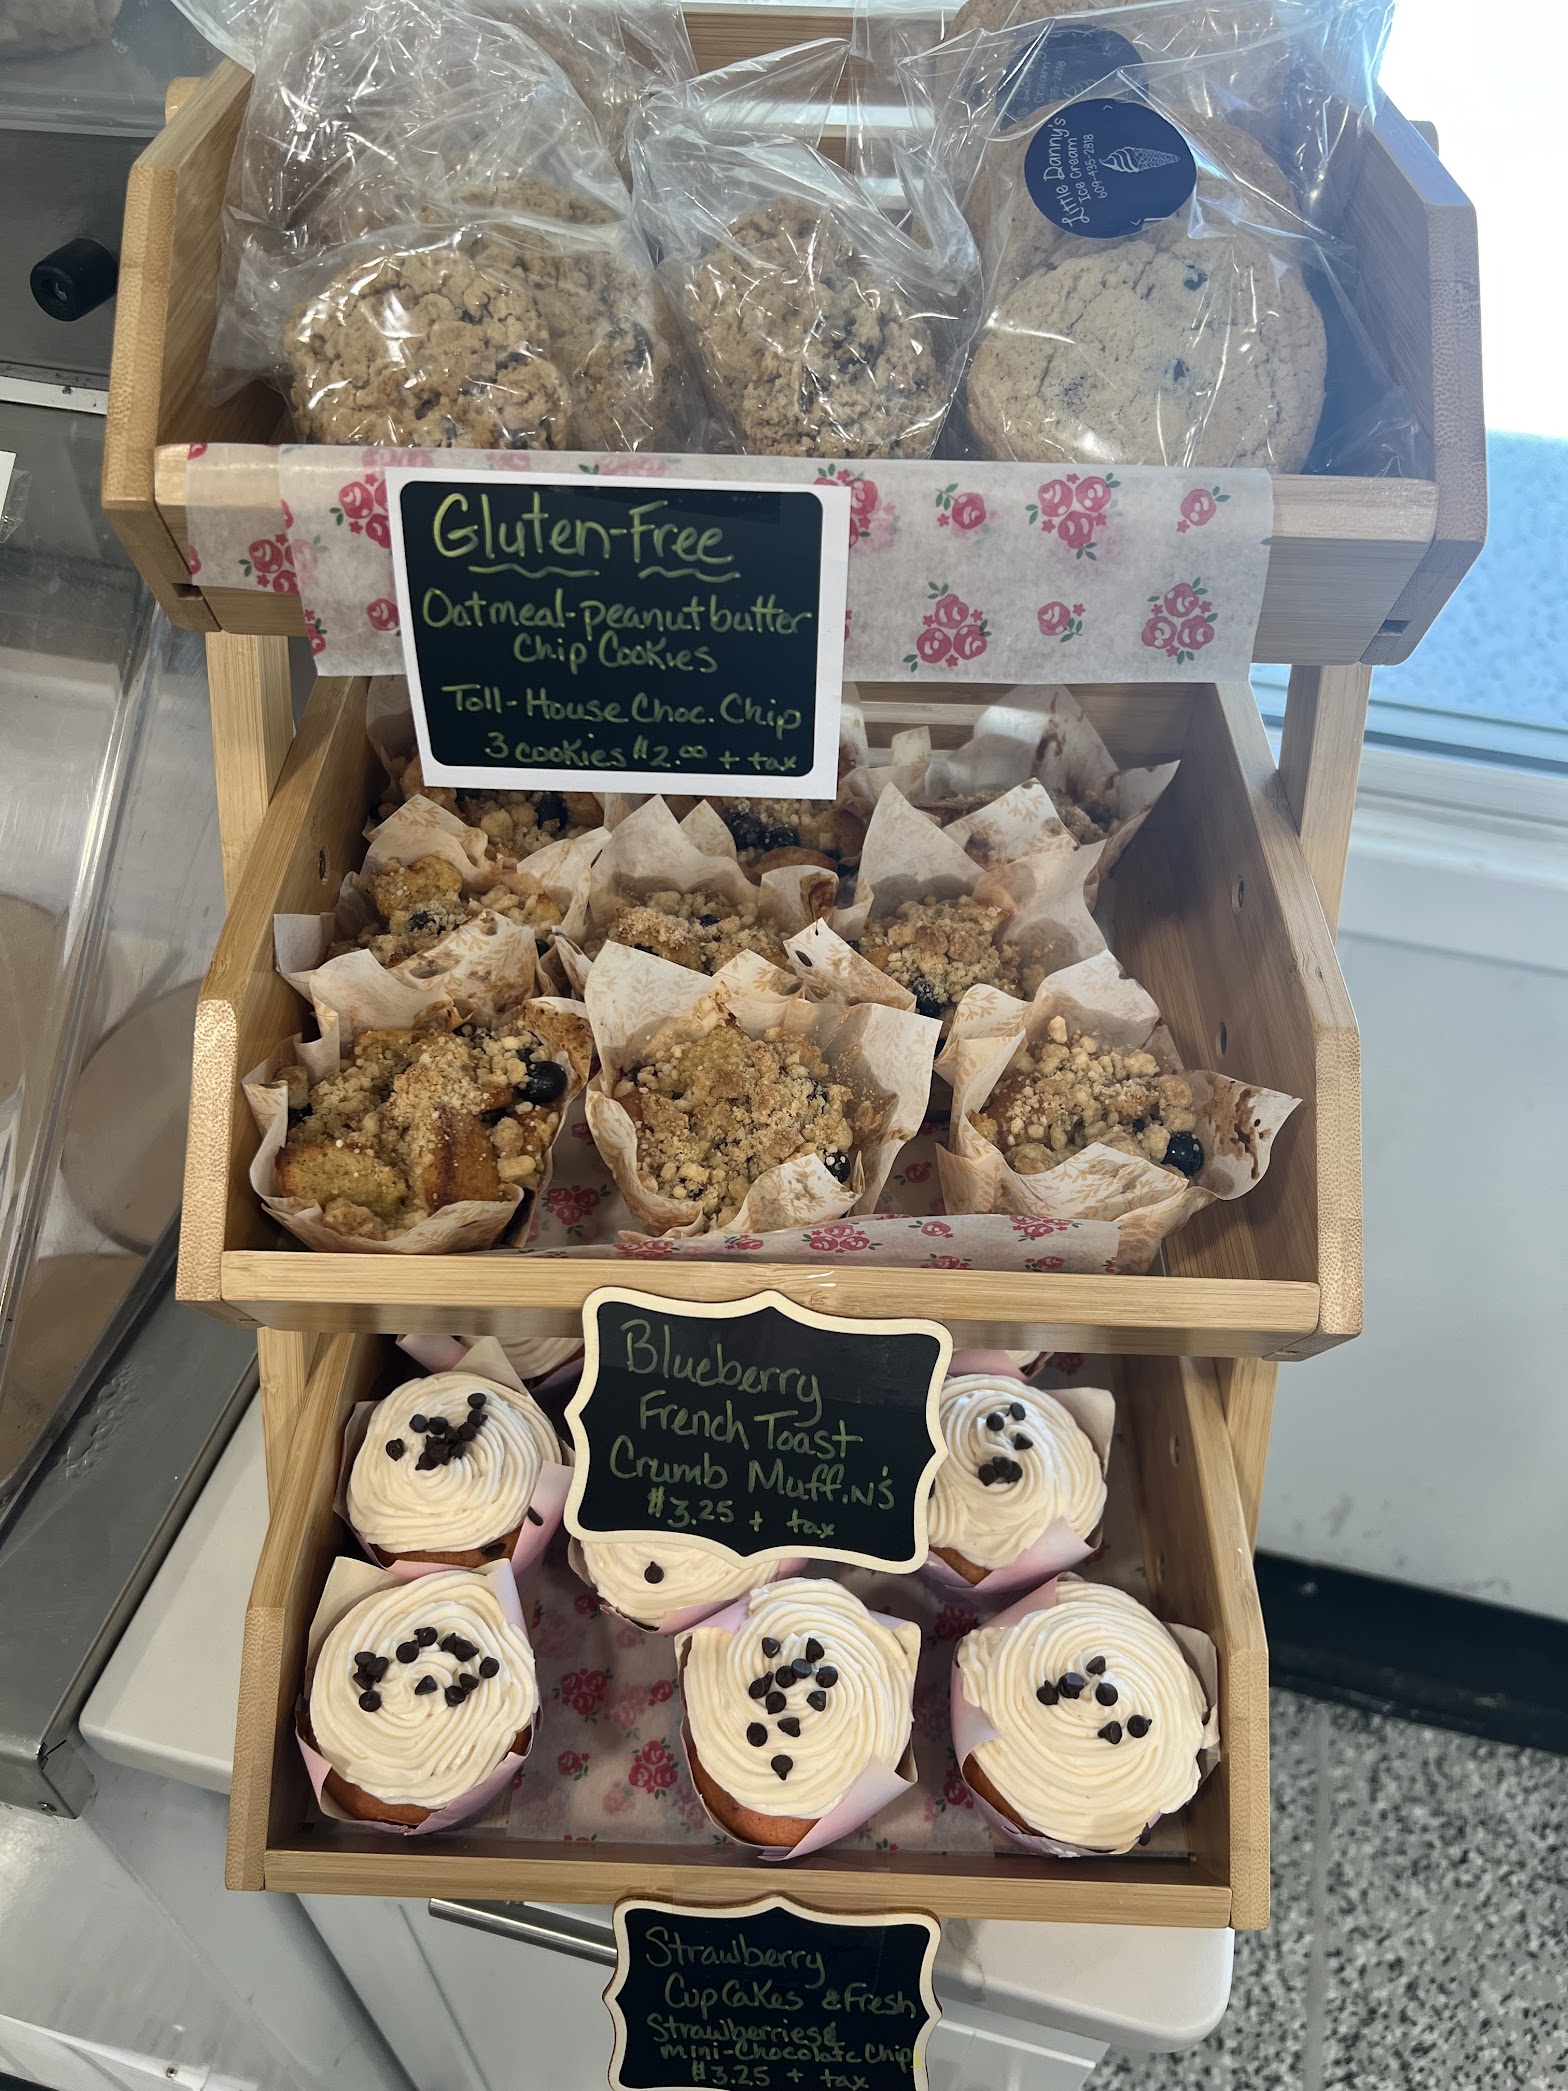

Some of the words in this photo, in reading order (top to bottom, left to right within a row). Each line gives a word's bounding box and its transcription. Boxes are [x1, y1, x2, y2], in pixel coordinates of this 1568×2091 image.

[1043, 117, 1070, 182] Danny's
[1068, 137, 1082, 179] Cream
[1083, 134, 1108, 199] 609-435-2818
[1056, 185, 1090, 227] Little
[1075, 182, 1091, 206] Ice
[433, 492, 735, 564] Gluten-Free
[513, 633, 587, 674] Chip
[632, 692, 714, 724] Choc.
[720, 693, 802, 741] Chip
[485, 731, 508, 759] 3
[719, 751, 740, 769] +
[747, 752, 798, 771] tax
[620, 1319, 823, 1428] Blueberry
[639, 1390, 750, 1450] French
[753, 1410, 864, 1459] Toast
[610, 1435, 728, 1489] Crumb
[749, 1510, 763, 1533] +
[786, 1508, 835, 1539] tax
[646, 1926, 826, 1988] Strawberry
[844, 1982, 916, 2019] Fresh
[787, 2068, 803, 2082] +
[820, 2068, 869, 2091] tax
